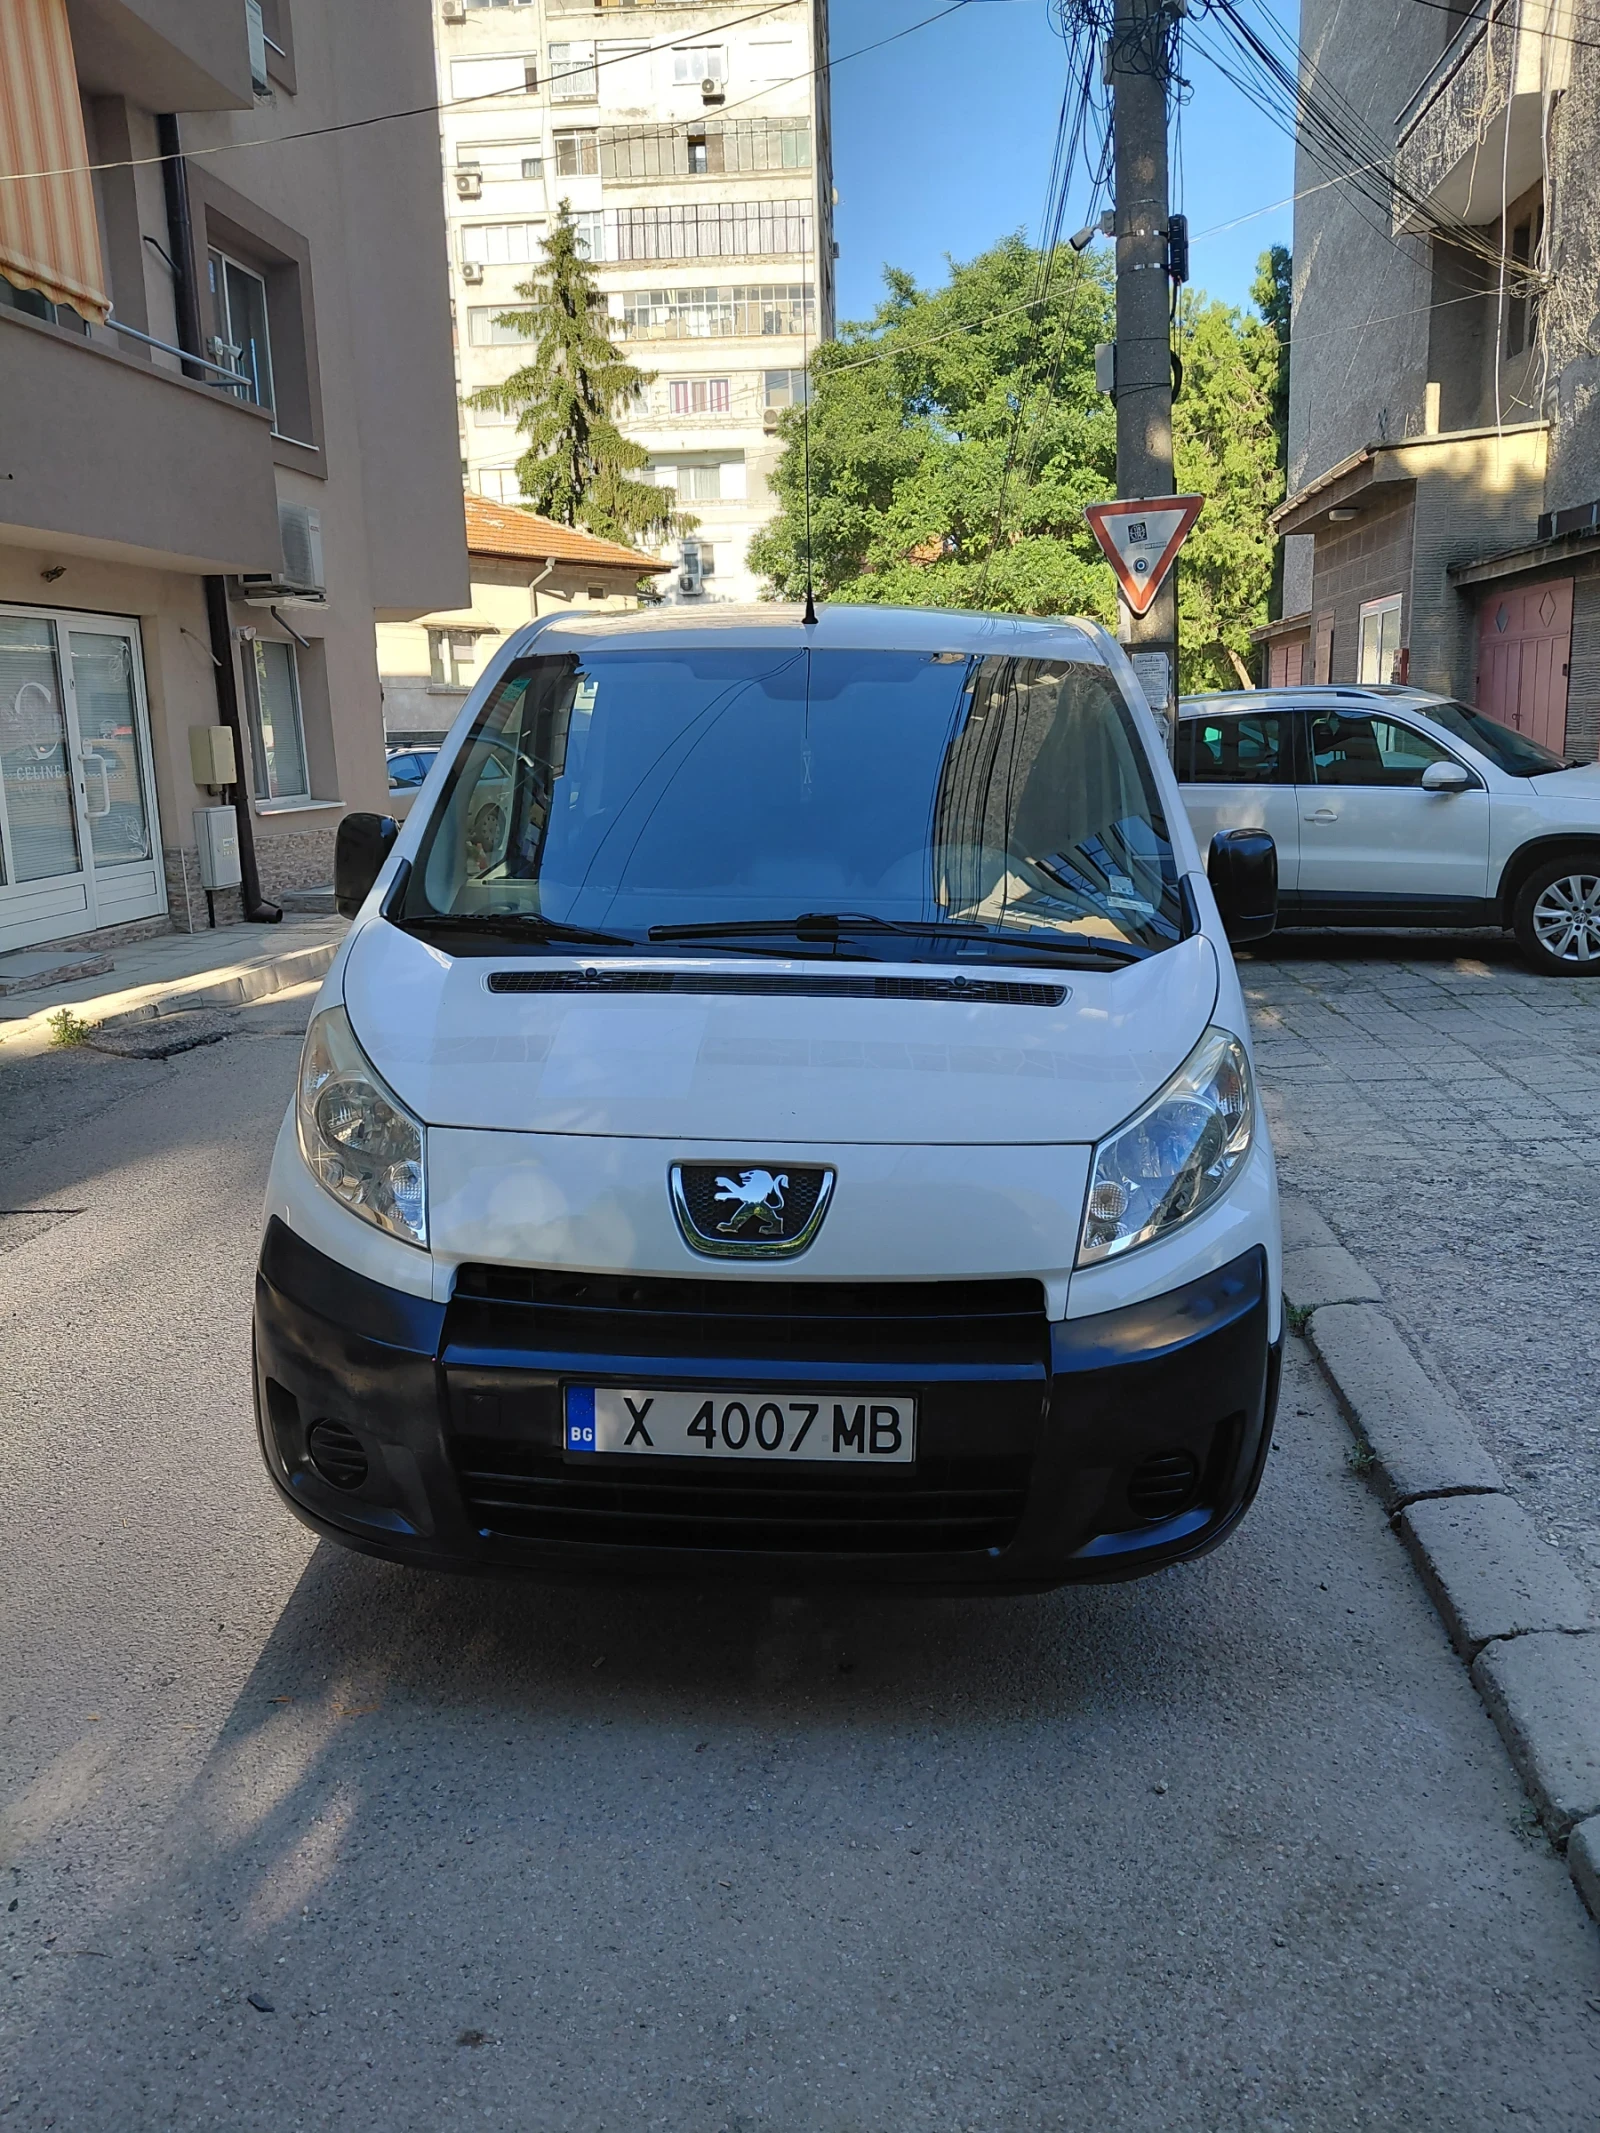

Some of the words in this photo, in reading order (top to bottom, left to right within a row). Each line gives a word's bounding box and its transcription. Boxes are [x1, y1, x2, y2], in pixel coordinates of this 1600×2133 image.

[16, 764, 62, 781] CELINE
[570, 1426, 593, 1442] BG
[622, 1397, 655, 1447] X
[686, 1400, 820, 1452] 4007
[831, 1403, 903, 1455] MB
